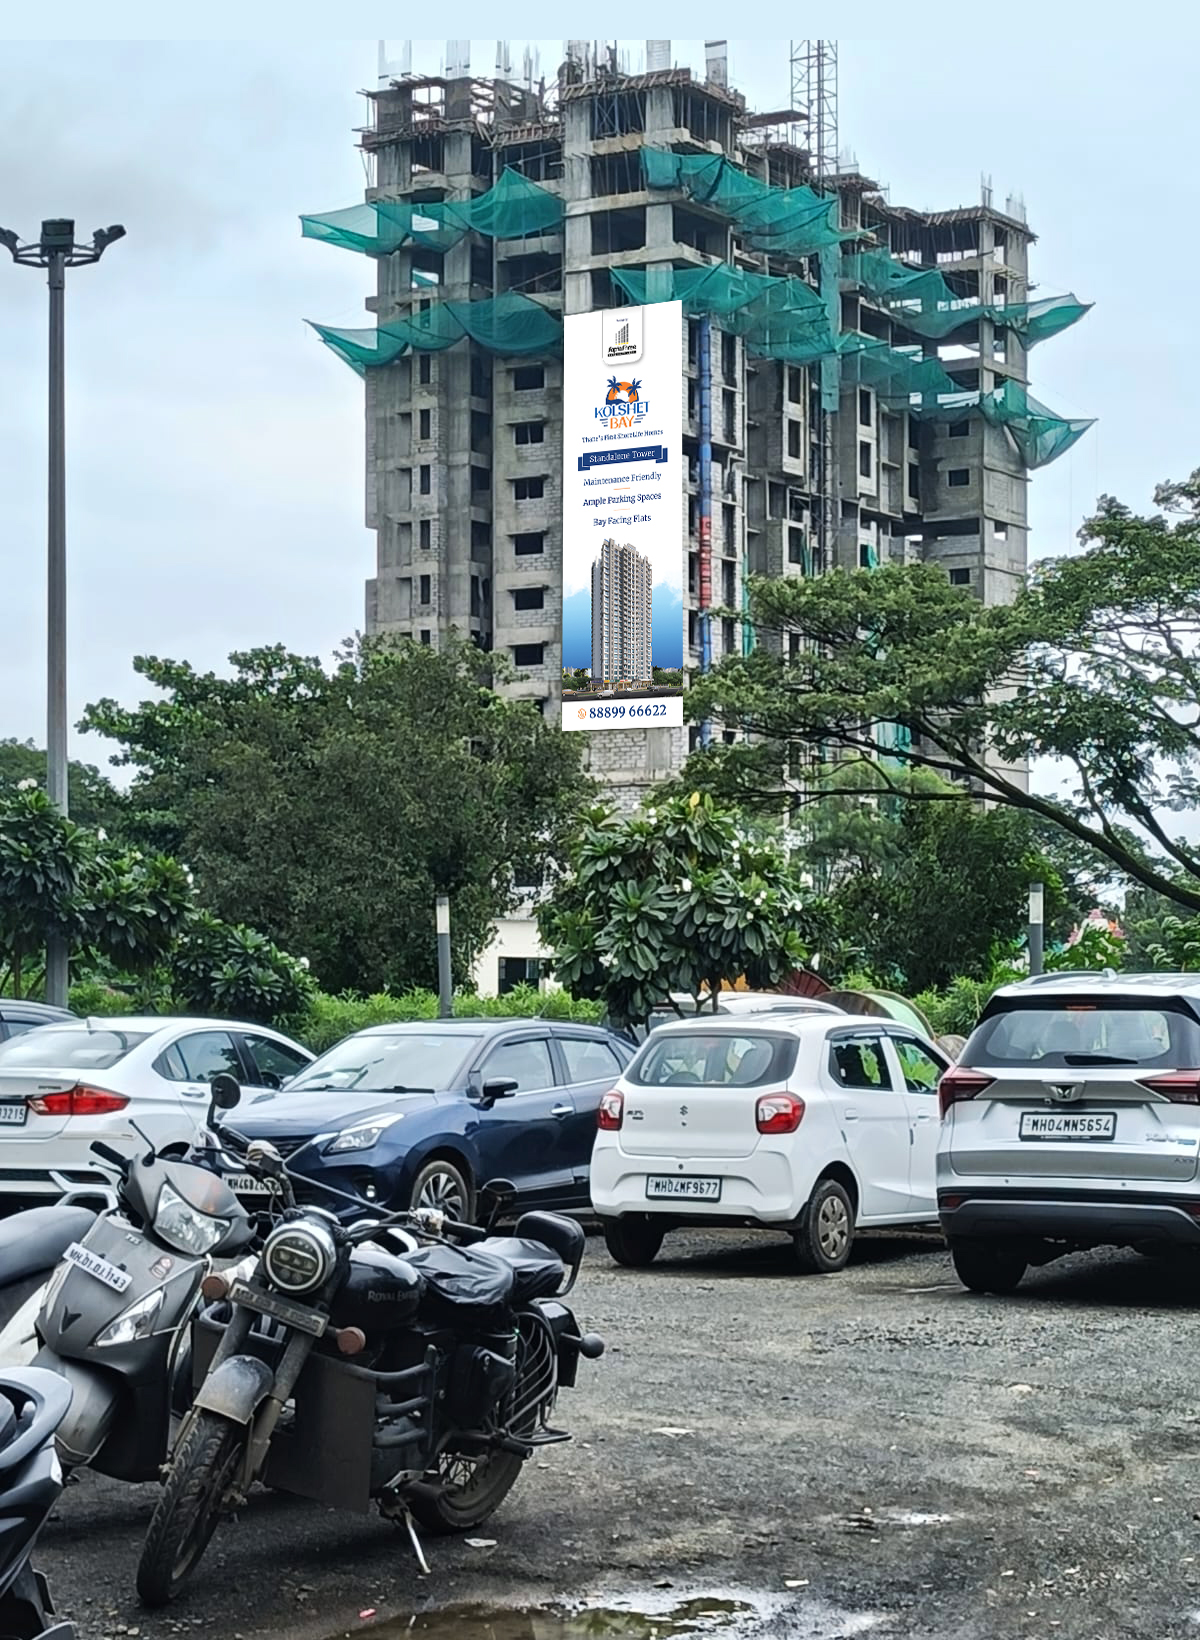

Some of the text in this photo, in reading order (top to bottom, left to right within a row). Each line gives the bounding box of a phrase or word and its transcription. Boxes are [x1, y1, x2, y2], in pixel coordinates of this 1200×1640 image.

[595, 401, 650, 418] KOLSHET
[610, 415, 634, 429] BAY
[589, 449, 655, 463] Standalone Tower
[583, 471, 661, 486] Maintenance Friendly
[583, 493, 661, 508] Ample Parking Spaces
[593, 514, 651, 527] Bay Facing Flats
[589, 704, 667, 719] 88899 66622
[1032, 1119, 1112, 1132] MH04MN5654
